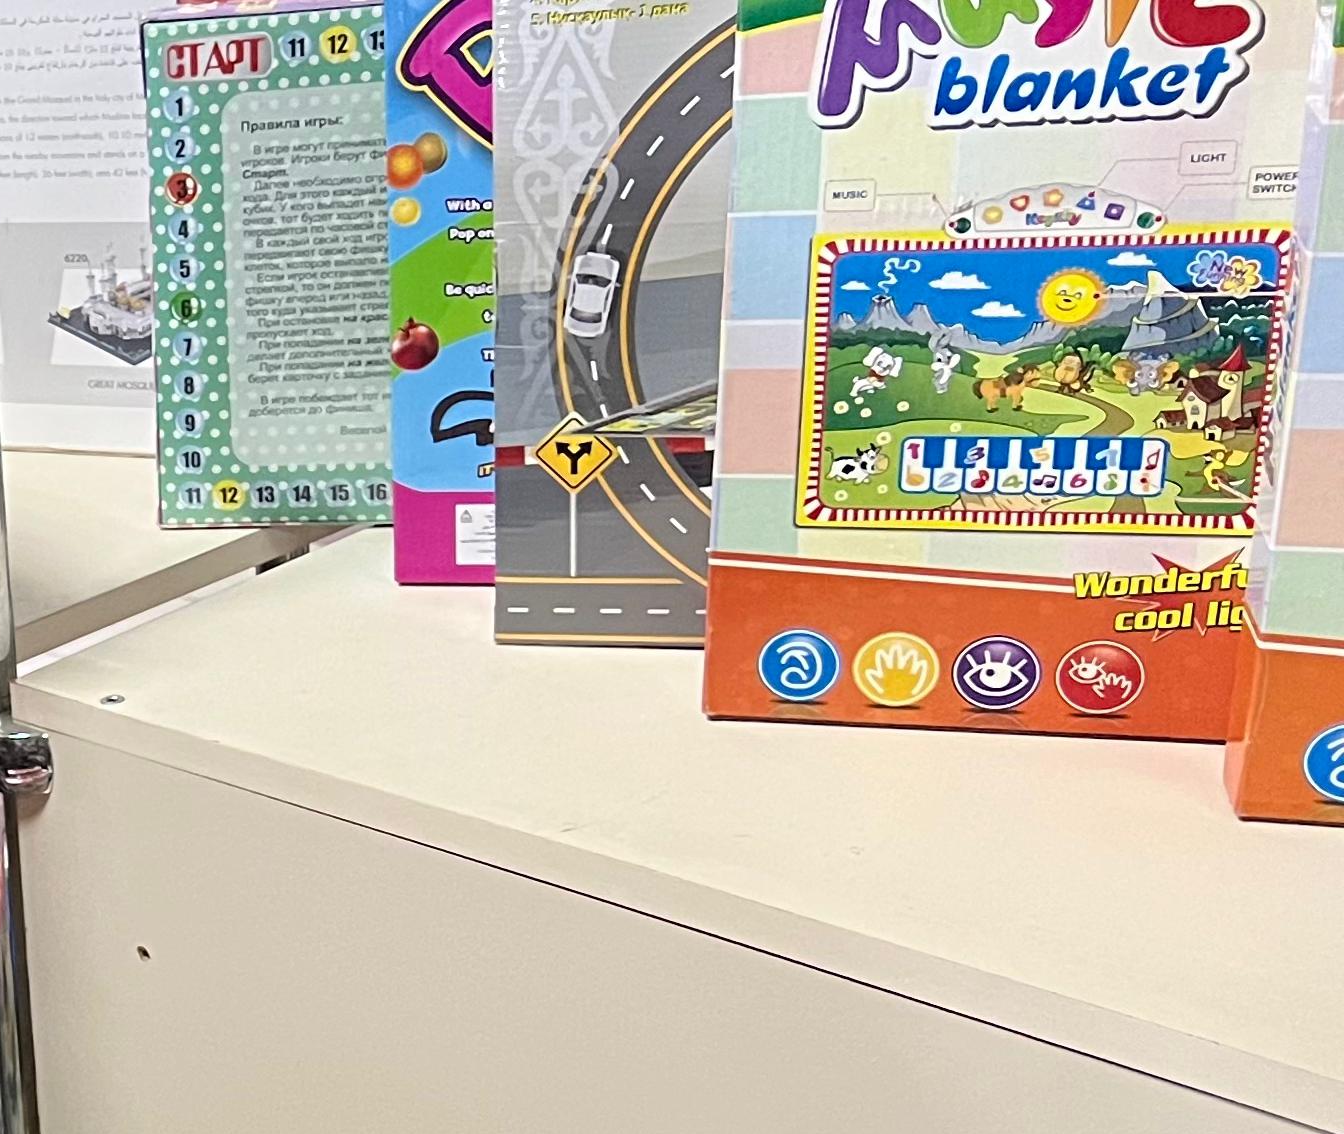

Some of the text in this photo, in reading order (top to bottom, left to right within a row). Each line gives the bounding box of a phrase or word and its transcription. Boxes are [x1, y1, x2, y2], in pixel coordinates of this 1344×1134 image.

[289, 38, 305, 57] 11
[327, 33, 348, 54] 12
[167, 37, 267, 79] СТАРТ
[933, 47, 1230, 117] blanket
[175, 98, 183, 116] 1
[241, 116, 344, 133] Правила игры:
[175, 139, 186, 158] 2
[1190, 152, 1227, 165] LIGHT
[242, 169, 288, 180] Старт.
[177, 180, 188, 199] 3
[832, 189, 868, 201] MUSIC
[446, 199, 480, 213] With
[178, 220, 189, 239] 4
[449, 228, 475, 243] Pop
[64, 254, 88, 263] 6220
[179, 259, 190, 278] 5
[445, 284, 464, 297] Be
[181, 300, 192, 318] 6
[184, 338, 193, 356] 7
[184, 377, 194, 394] 8
[185, 415, 196, 432] 9
[182, 451, 201, 468] 10
[185, 483, 387, 504] 11 12 13 14 15 16
[1113, 602, 1194, 633] cool
